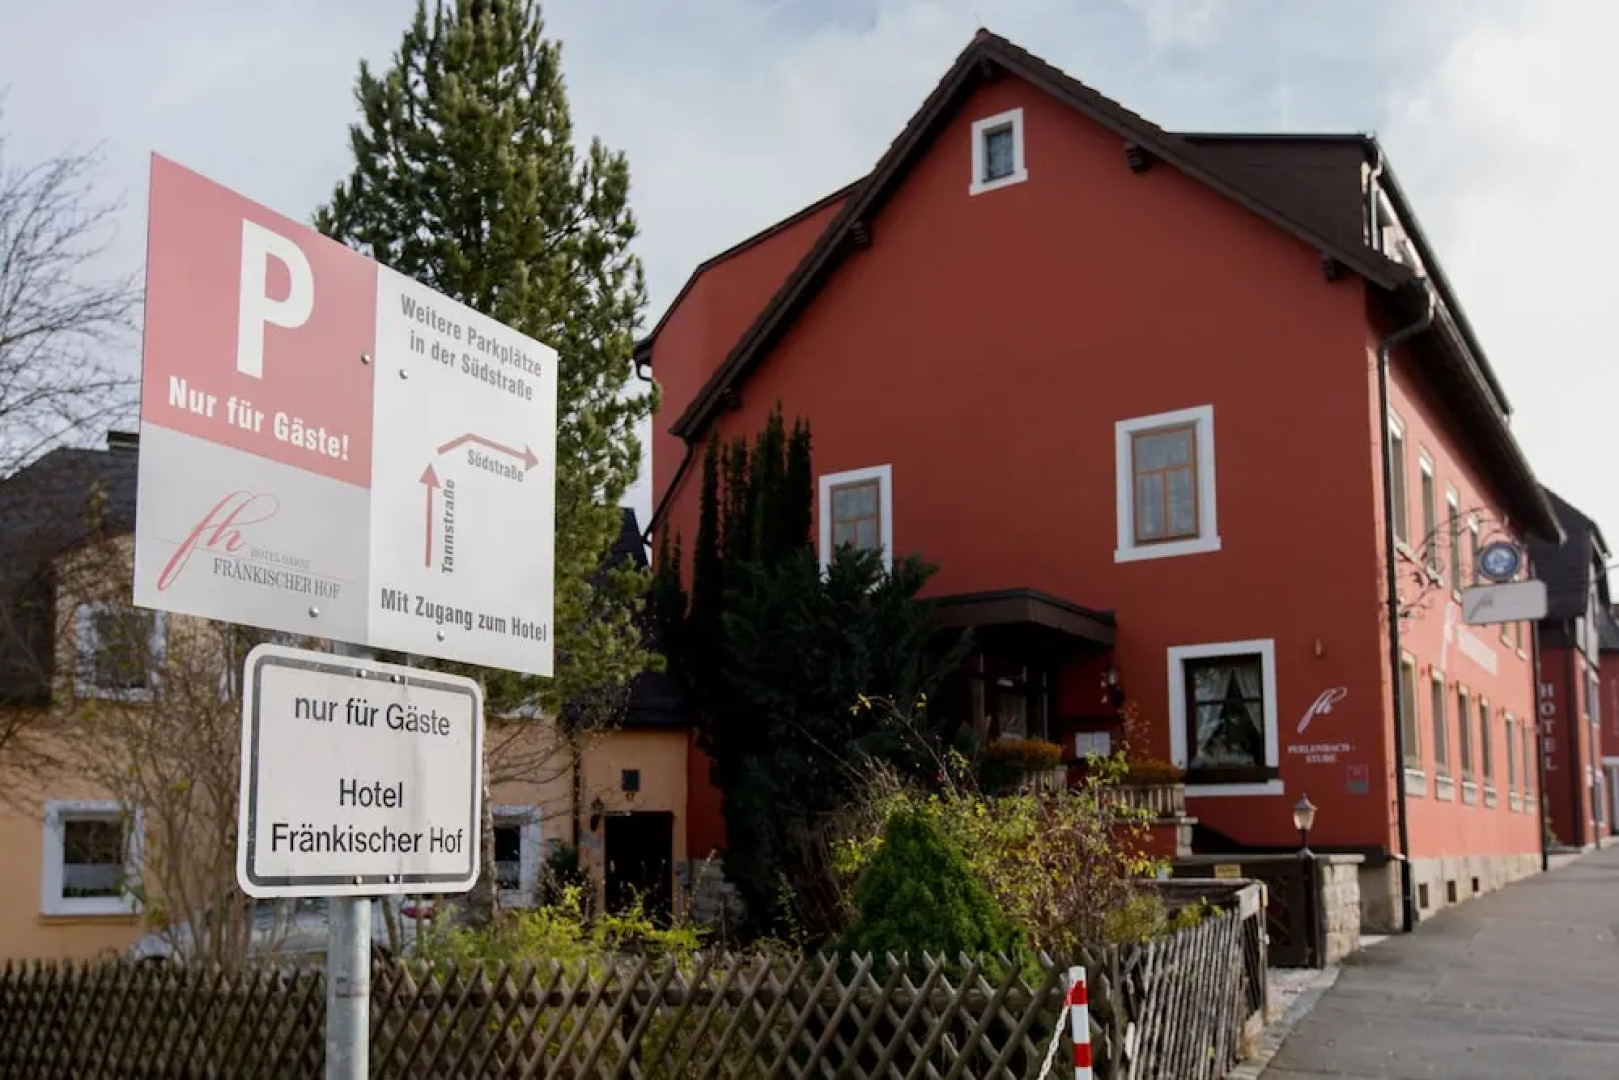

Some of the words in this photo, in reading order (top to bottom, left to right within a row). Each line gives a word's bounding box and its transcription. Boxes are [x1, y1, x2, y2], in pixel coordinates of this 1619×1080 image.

[236, 218, 315, 379] P
[400, 294, 462, 341] Weitere
[467, 326, 542, 378] Parkplätze
[409, 332, 426, 354] in
[430, 340, 457, 368] der
[461, 348, 533, 401] Südstraße
[168, 375, 216, 419] Nur
[227, 394, 264, 431] für
[273, 411, 351, 462] Gäste!
[467, 449, 524, 483] Südstraße
[441, 479, 456, 574] Tannstraße
[213, 557, 312, 594] FRÄNKISCHER
[314, 579, 341, 599] HOF
[250, 547, 280, 563] HOTEL
[381, 588, 409, 613] Mit
[414, 594, 476, 632] Zugang
[477, 611, 507, 633] zum
[511, 614, 547, 643] Hotel
[295, 696, 338, 722] nur
[345, 698, 379, 728] für
[386, 703, 450, 736] Gäste
[1540, 682, 1558, 771] HOTEL
[338, 778, 403, 808] Hotel
[271, 822, 423, 854] Fränkischer
[429, 826, 463, 854] Hof
